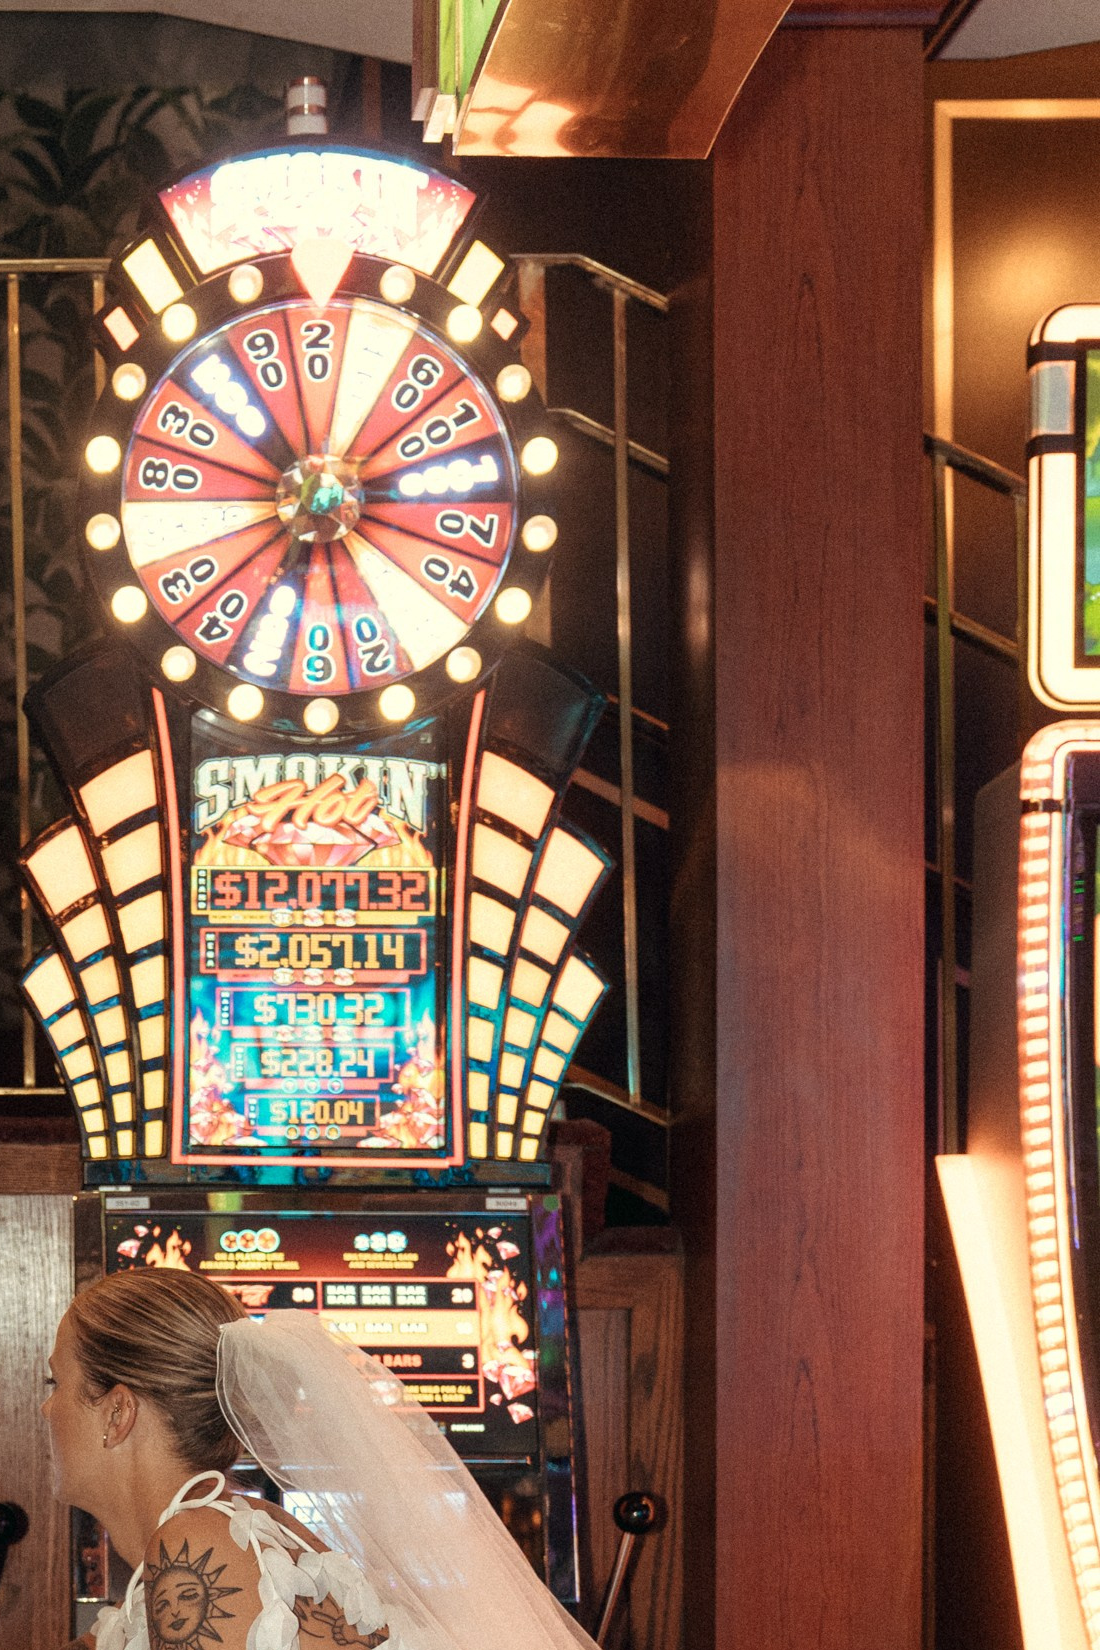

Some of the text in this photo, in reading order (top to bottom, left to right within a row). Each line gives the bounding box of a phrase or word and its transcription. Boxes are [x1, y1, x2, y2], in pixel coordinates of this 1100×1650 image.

[242, 329, 288, 391] 90
[301, 319, 335, 383] 20
[390, 354, 444, 412] 60
[157, 401, 219, 449] 30
[396, 399, 480, 461] 100
[138, 457, 202, 492] 80
[436, 509, 498, 547] 70
[158, 555, 219, 604] 30
[420, 555, 479, 603] 40
[194, 589, 248, 644] 40
[351, 612, 395, 676] 20
[247, 773, 380, 832] Hot
[214, 872, 426, 909] $12,077.32
[234, 934, 405, 968] $2,057.14
[253, 993, 385, 1026] $730.32
[260, 1048, 375, 1077] $228.24
[270, 1100, 364, 1124] $120.04
[326, 1285, 426, 1295] BAR BAR BAR
[451, 1287, 474, 1304] 20
[382, 1354, 422, 1368] BARS
[461, 1353, 475, 1369] 3
